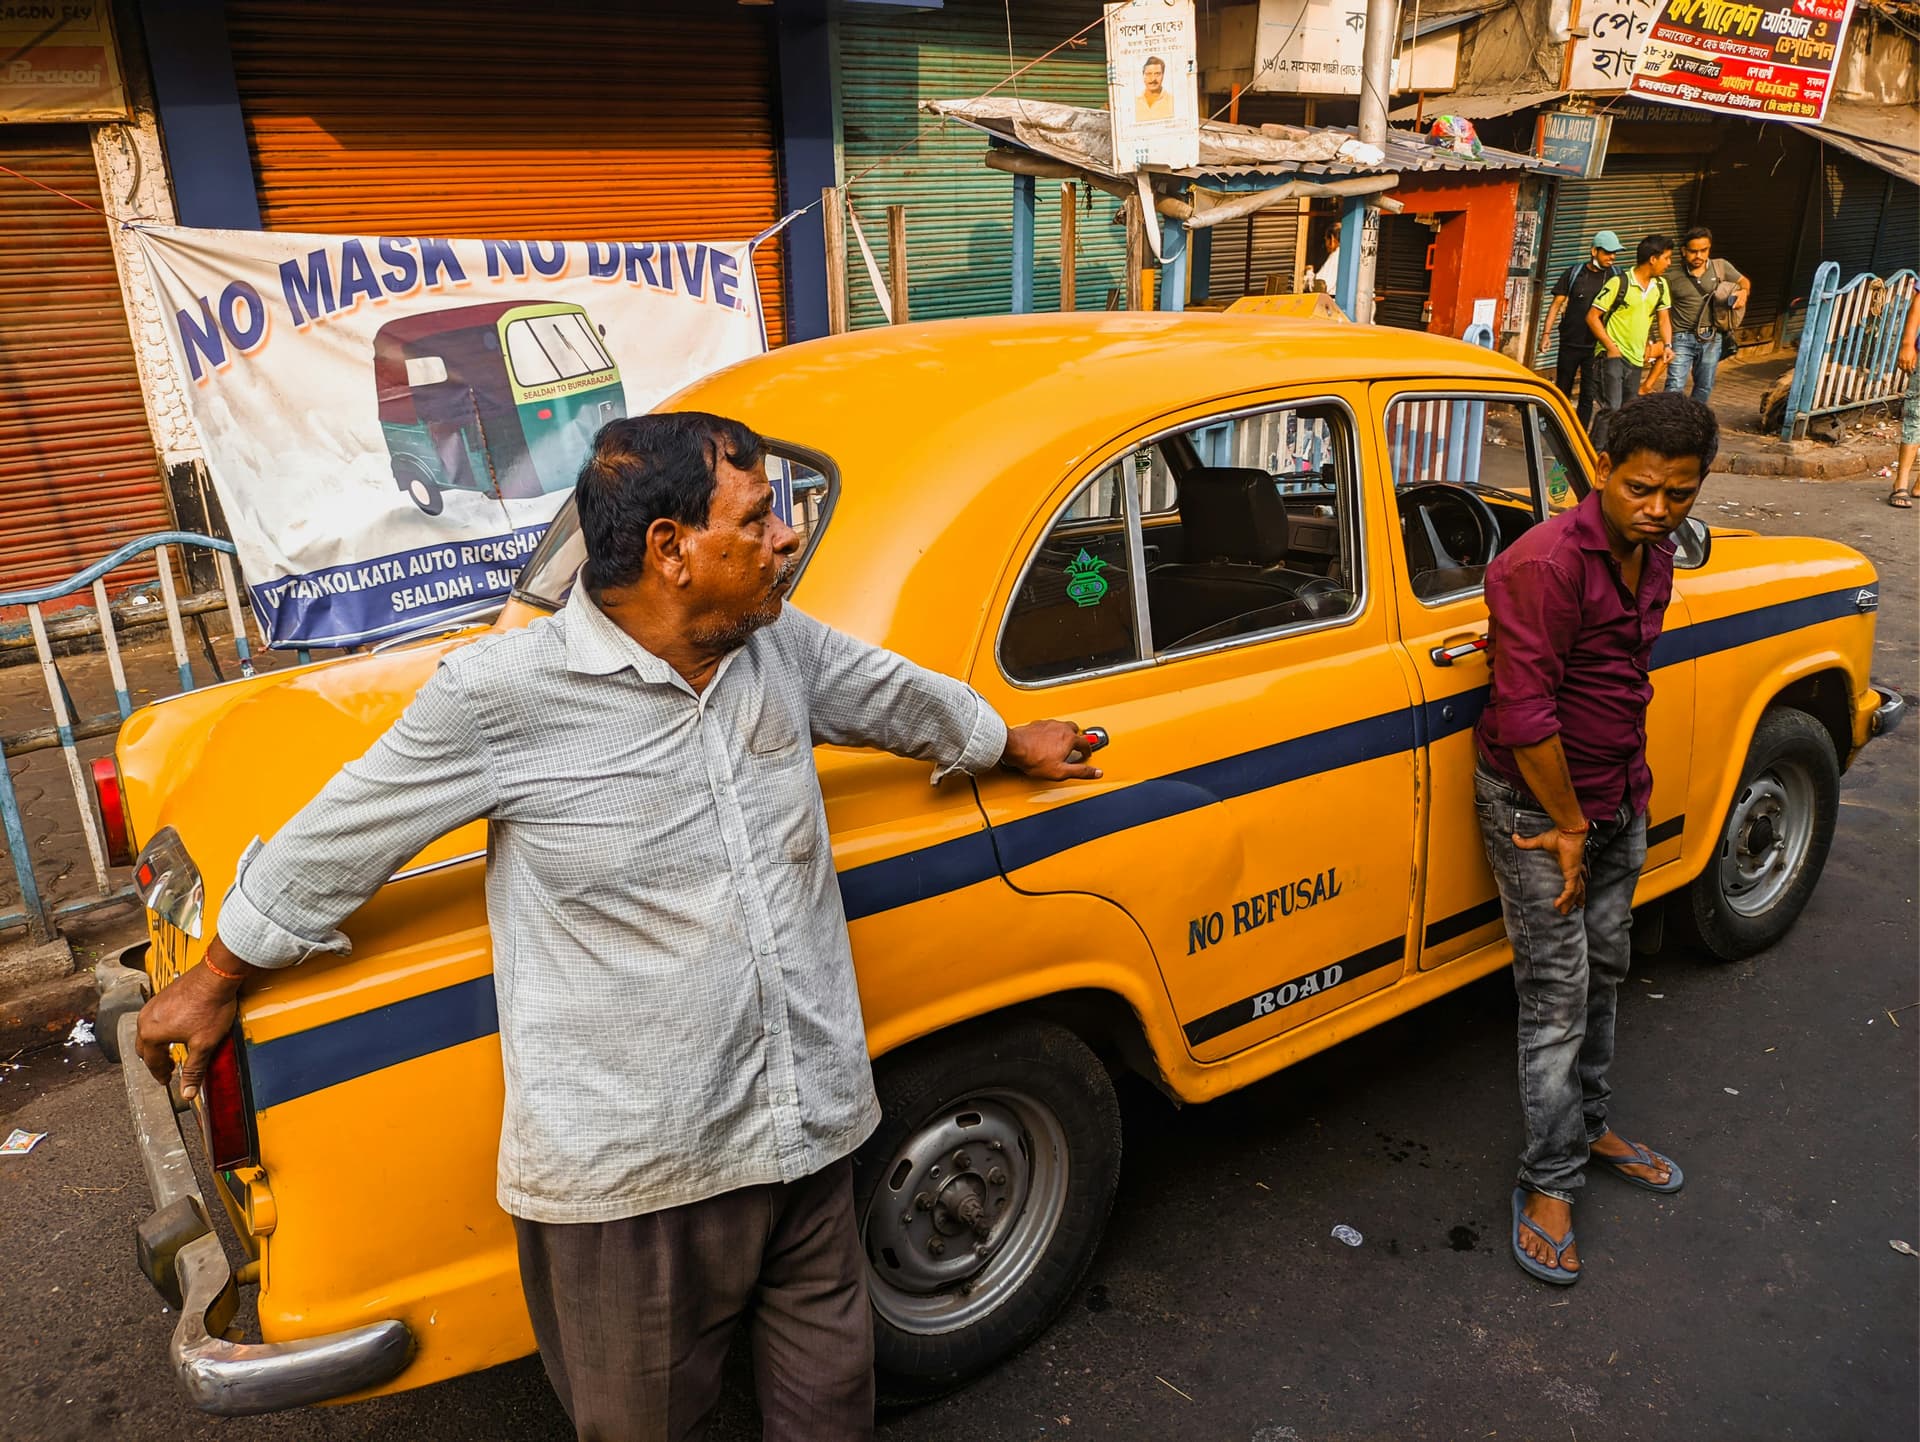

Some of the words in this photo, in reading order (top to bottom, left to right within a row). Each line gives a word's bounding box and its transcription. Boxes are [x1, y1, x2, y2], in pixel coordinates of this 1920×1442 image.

[1815, 22, 1827, 37] ও
[175, 279, 266, 382] NO
[278, 236, 466, 328] MASK
[481, 240, 567, 278] NO
[523, 386, 556, 400] SEALDAH
[557, 384, 567, 394] TO
[568, 374, 614, 390] BURRABAZAR
[409, 548, 457, 577] AUTO
[391, 575, 474, 612] SEALDAH
[1187, 911, 1224, 956] NO
[1232, 867, 1343, 936] REFUSAL
[1252, 964, 1343, 1018] ROAD
